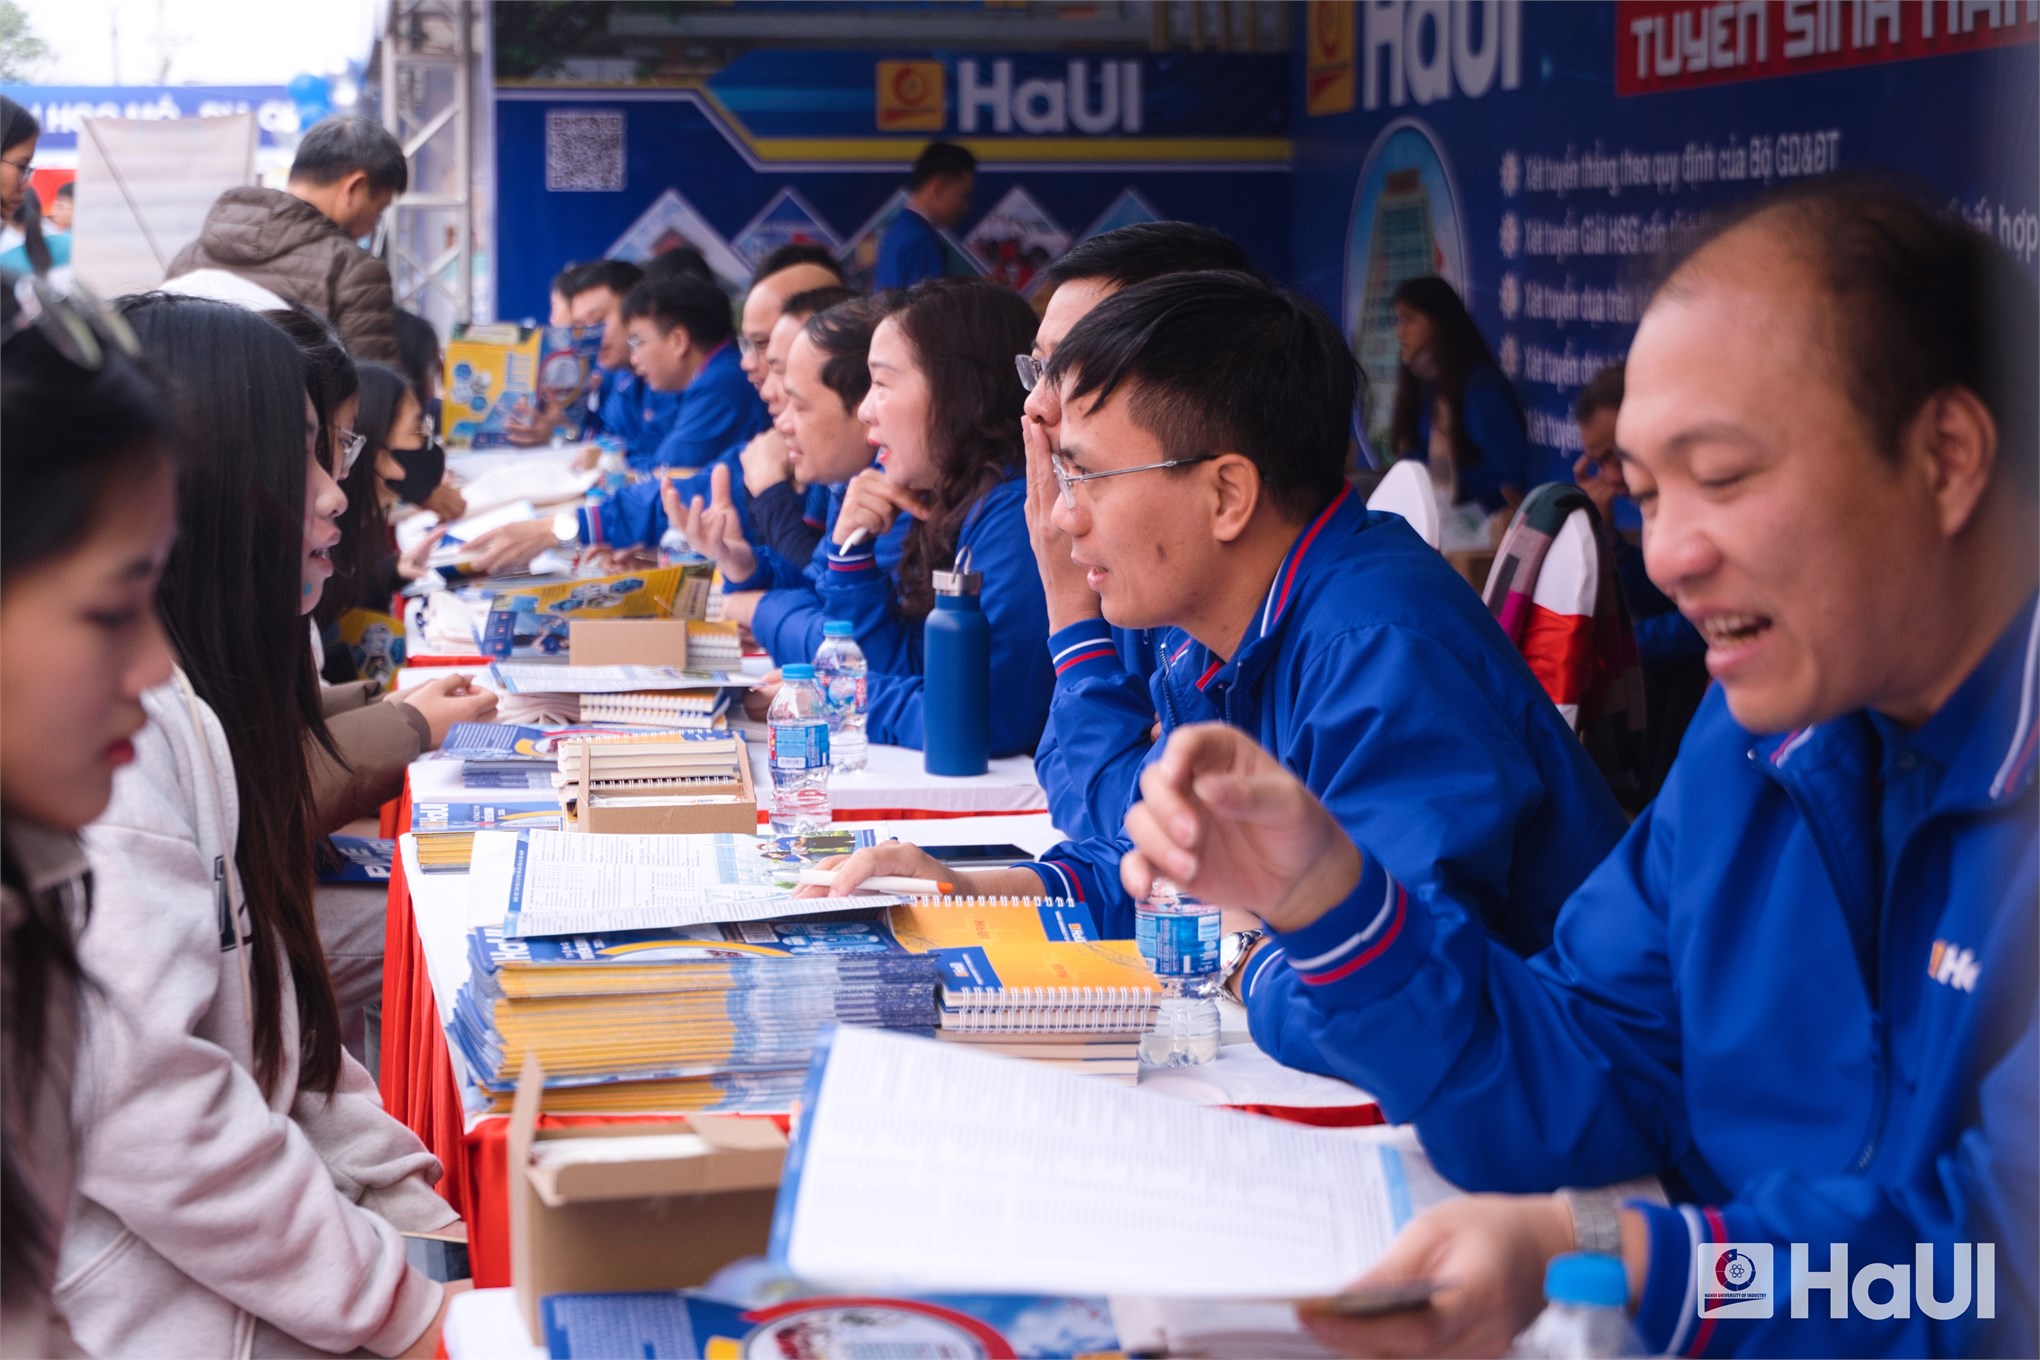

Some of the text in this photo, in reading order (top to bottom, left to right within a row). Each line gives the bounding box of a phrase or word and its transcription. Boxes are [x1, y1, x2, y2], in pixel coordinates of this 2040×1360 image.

[1362, 0, 1520, 111] HaUI
[957, 60, 1141, 133] HaUI
[1652, 152, 1678, 193] quy
[1681, 142, 1714, 190] định
[1718, 135, 1746, 181] của
[1750, 136, 1773, 186] Bộ
[1775, 131, 1840, 176] GD&ĐT
